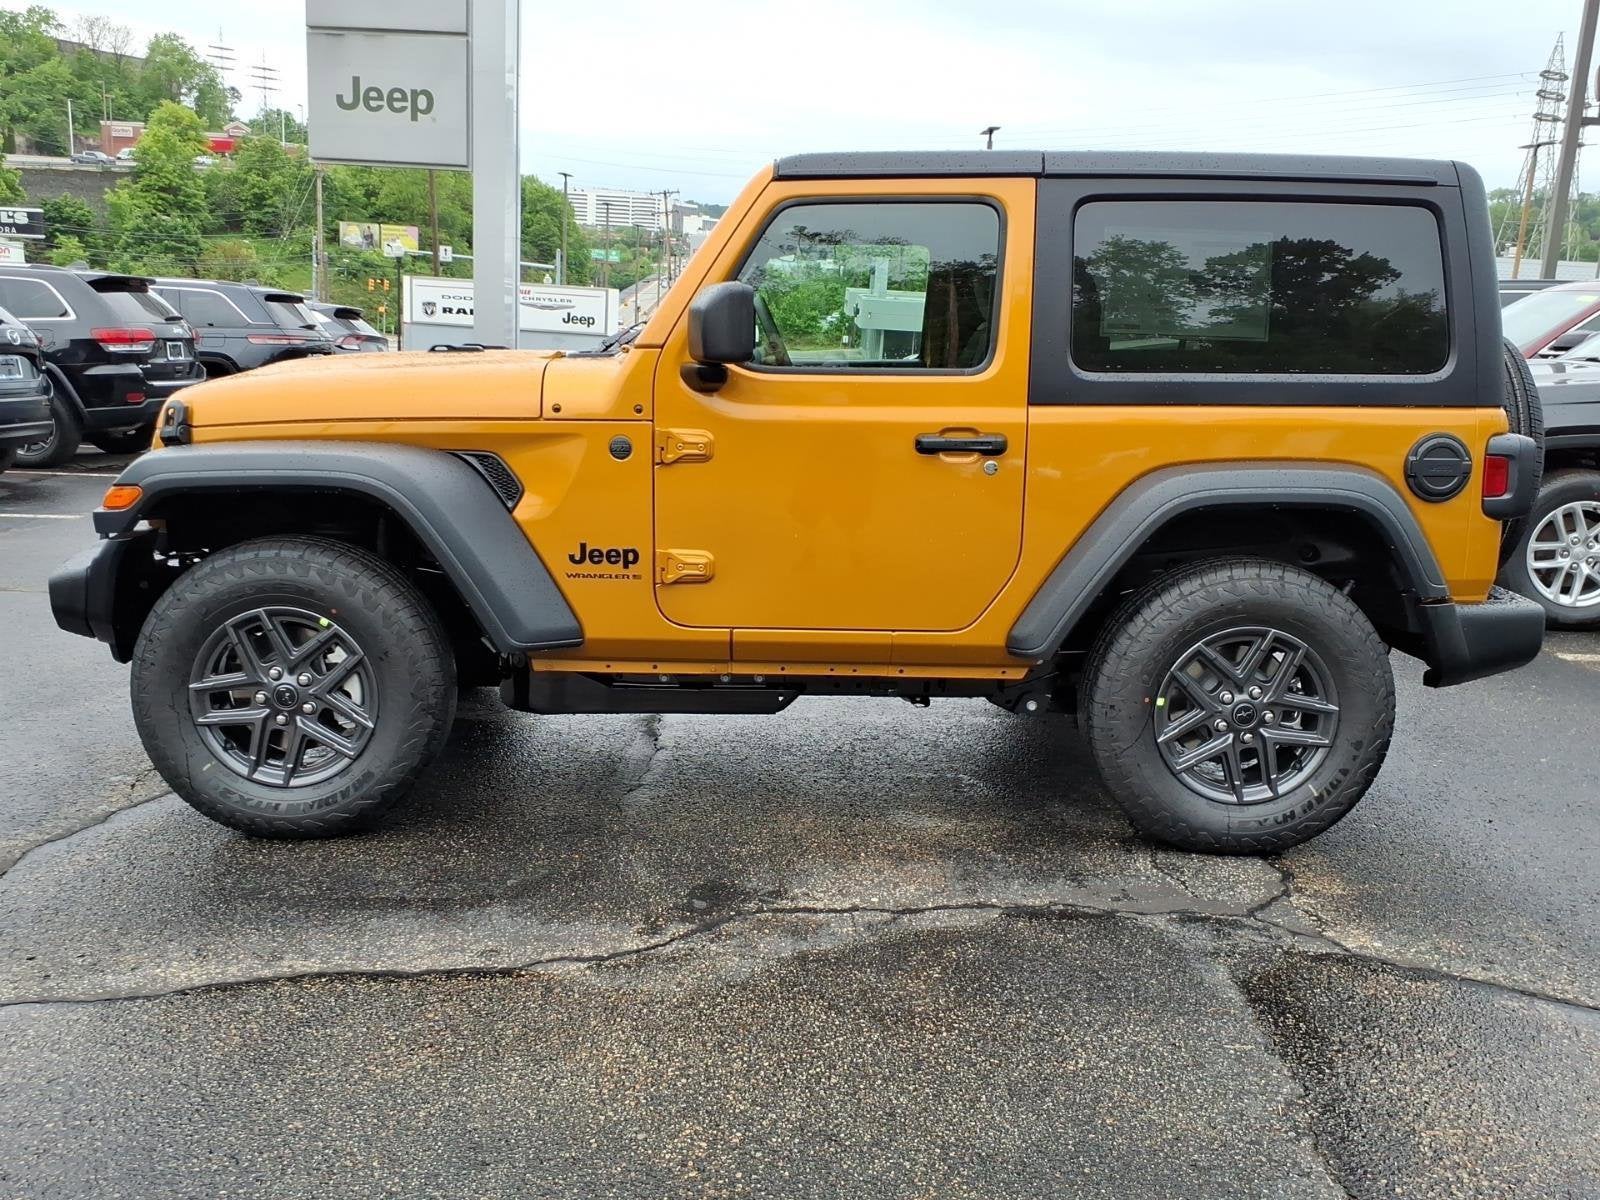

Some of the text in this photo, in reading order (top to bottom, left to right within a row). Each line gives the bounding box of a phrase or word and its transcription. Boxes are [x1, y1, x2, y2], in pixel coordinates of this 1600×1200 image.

[336, 75, 435, 122] Jeep
[442, 307, 474, 316] RA
[562, 312, 596, 328] Jeep
[568, 542, 640, 569] Jeep
